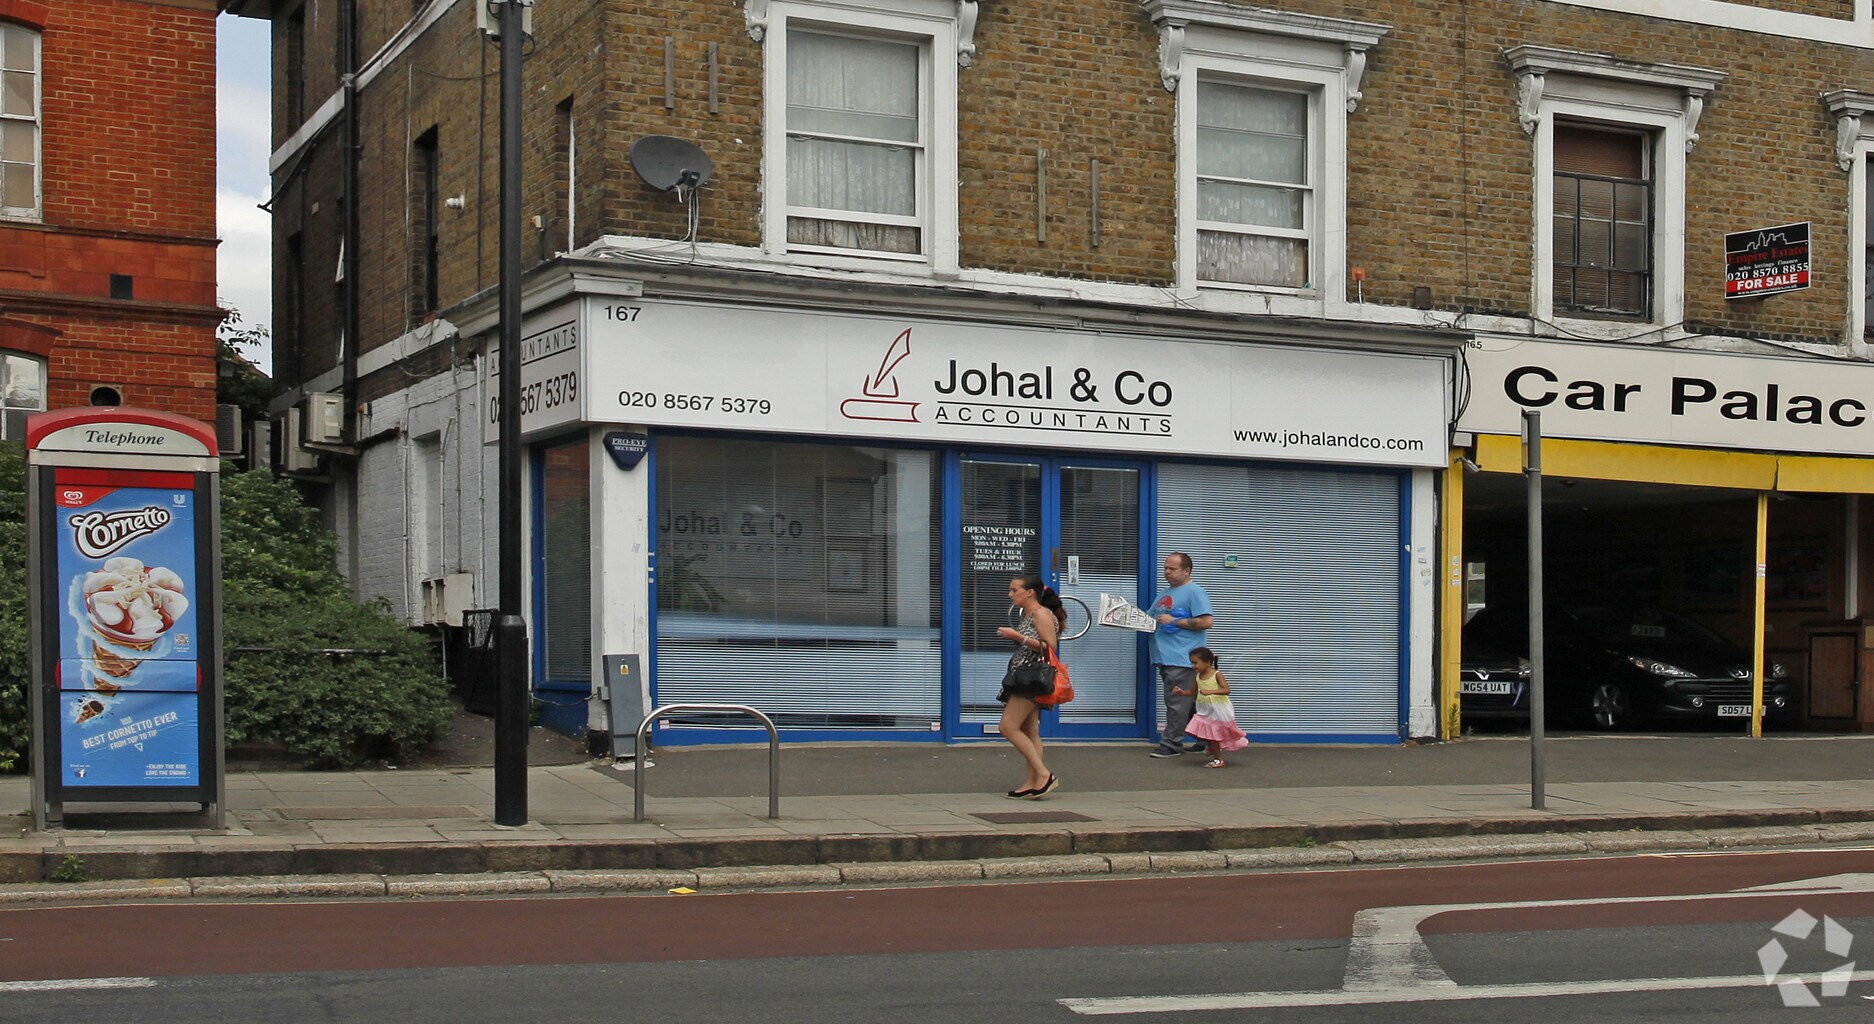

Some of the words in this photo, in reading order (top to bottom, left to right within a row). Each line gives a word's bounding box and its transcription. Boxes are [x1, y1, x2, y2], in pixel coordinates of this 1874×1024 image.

[1727, 271, 1748, 281] 020
[1753, 267, 1778, 278] 8570
[1782, 262, 1808, 274] 8855
[1737, 279, 1762, 291] FOR
[1766, 273, 1798, 287] SALE
[604, 305, 641, 322] 167
[490, 326, 576, 374] AUNTANTS
[1466, 340, 1482, 350] 165
[521, 381, 542, 416] 567
[545, 371, 577, 409] 5379
[934, 359, 1052, 400] Johal
[1070, 367, 1100, 403] &
[1114, 370, 1173, 407] Co
[618, 391, 657, 408] 020
[663, 393, 714, 411] 8567
[721, 397, 771, 415] 5379
[1503, 365, 1642, 412] Car
[1671, 376, 1872, 428] Palac
[935, 406, 1171, 433] ACCOUNTANTS
[85, 430, 165, 447] Telephone
[612, 437, 647, 446] PRO-EYE
[1233, 429, 1424, 452] www.johalandco.com
[69, 507, 170, 558] Cornetto
[740, 512, 758, 537] &
[769, 514, 803, 539] Co
[963, 525, 1003, 534] OPENING
[1005, 527, 1036, 536] HOURS
[1463, 682, 1488, 692] WG54
[1490, 683, 1507, 692] UAT
[82, 734, 106, 749] BEST
[107, 719, 153, 741] CORNETTO
[153, 711, 178, 727] EVER
[110, 740, 127, 750] FROM
